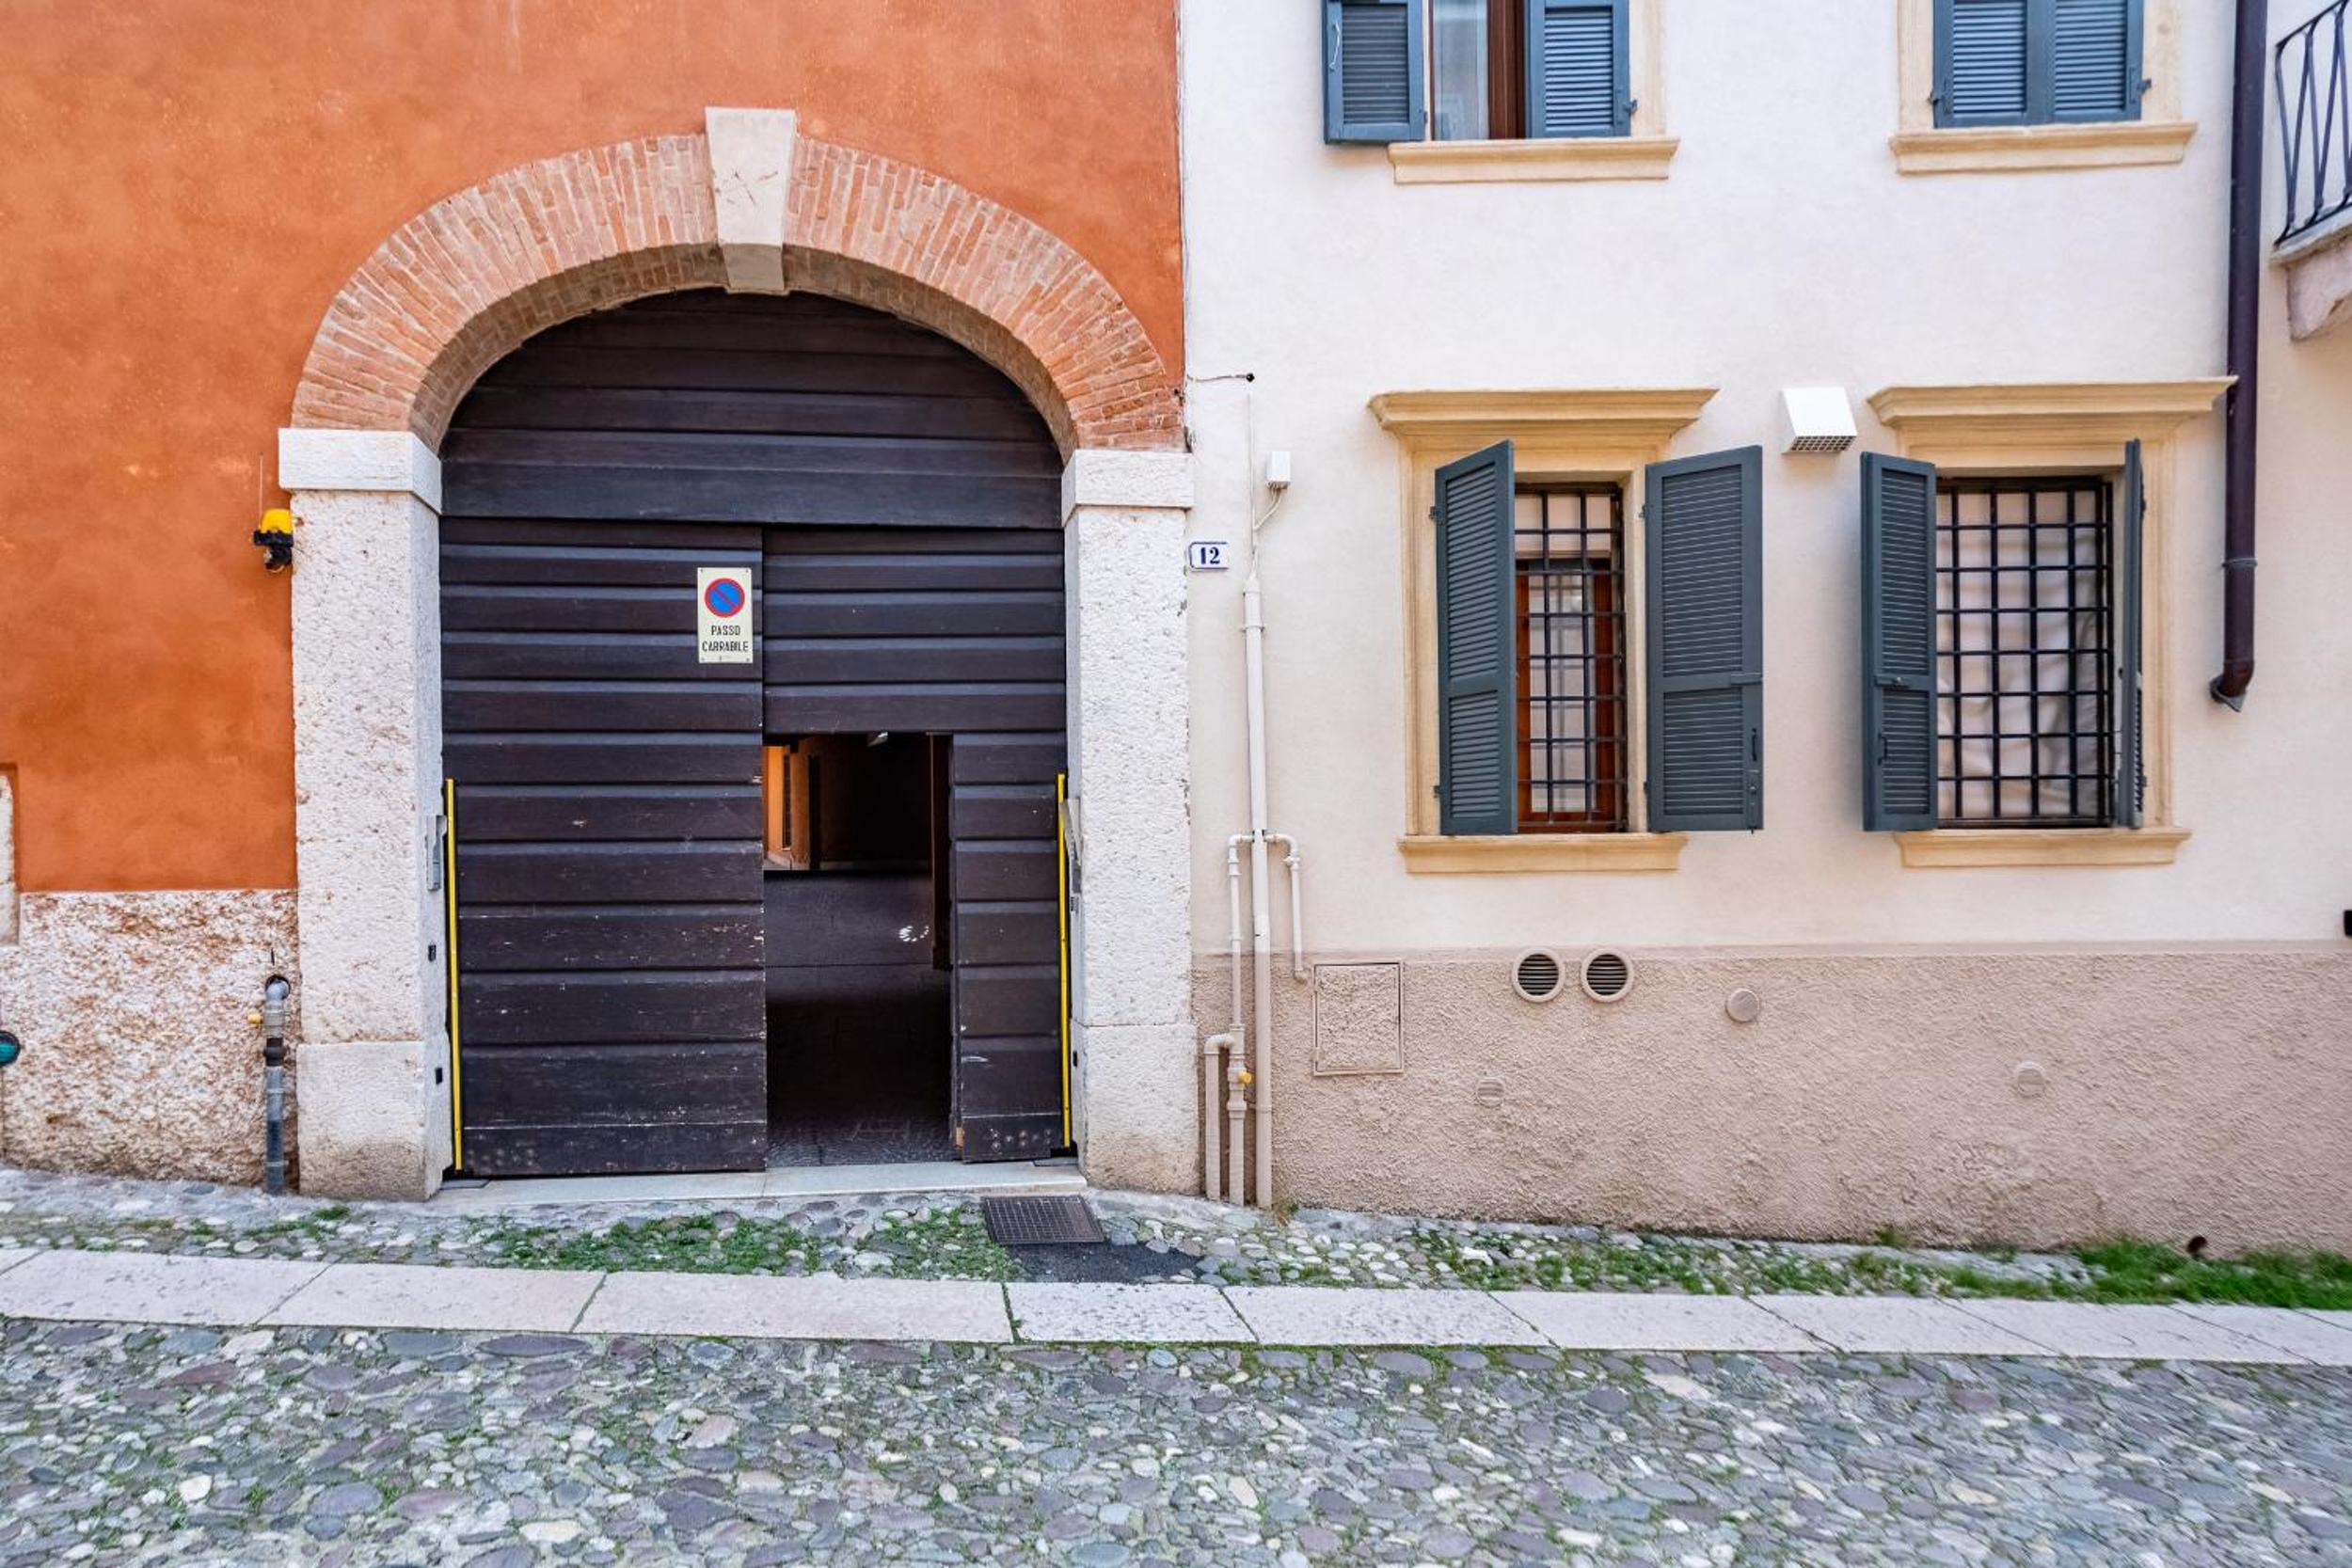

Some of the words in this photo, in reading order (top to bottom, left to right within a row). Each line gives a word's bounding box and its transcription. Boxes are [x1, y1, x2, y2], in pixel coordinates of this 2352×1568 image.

[1200, 546, 1220, 564] 12
[711, 625, 741, 636] PASSO
[702, 641, 749, 652] CARRABILE
